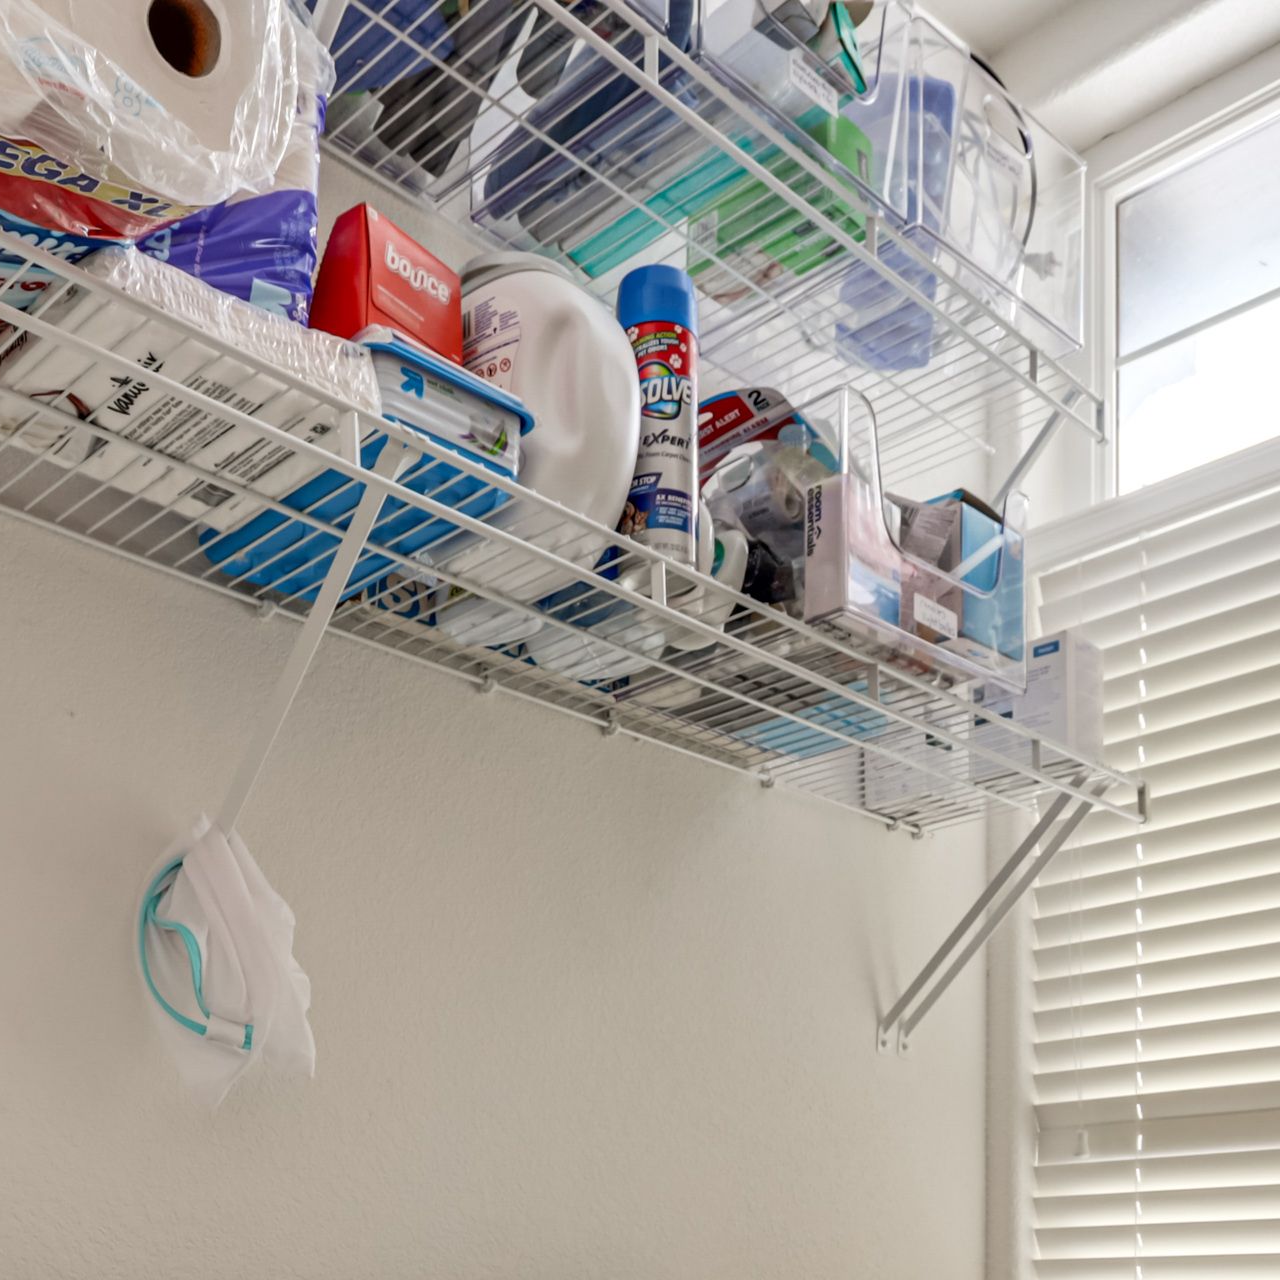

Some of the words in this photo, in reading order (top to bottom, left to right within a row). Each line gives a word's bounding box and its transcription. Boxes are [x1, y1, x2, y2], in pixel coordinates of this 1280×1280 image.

[384, 240, 452, 305] bounce
[640, 376, 693, 406] SOLVE
[748, 389, 767, 407] 2
[814, 484, 823, 522] room
[807, 488, 817, 557] essentials
